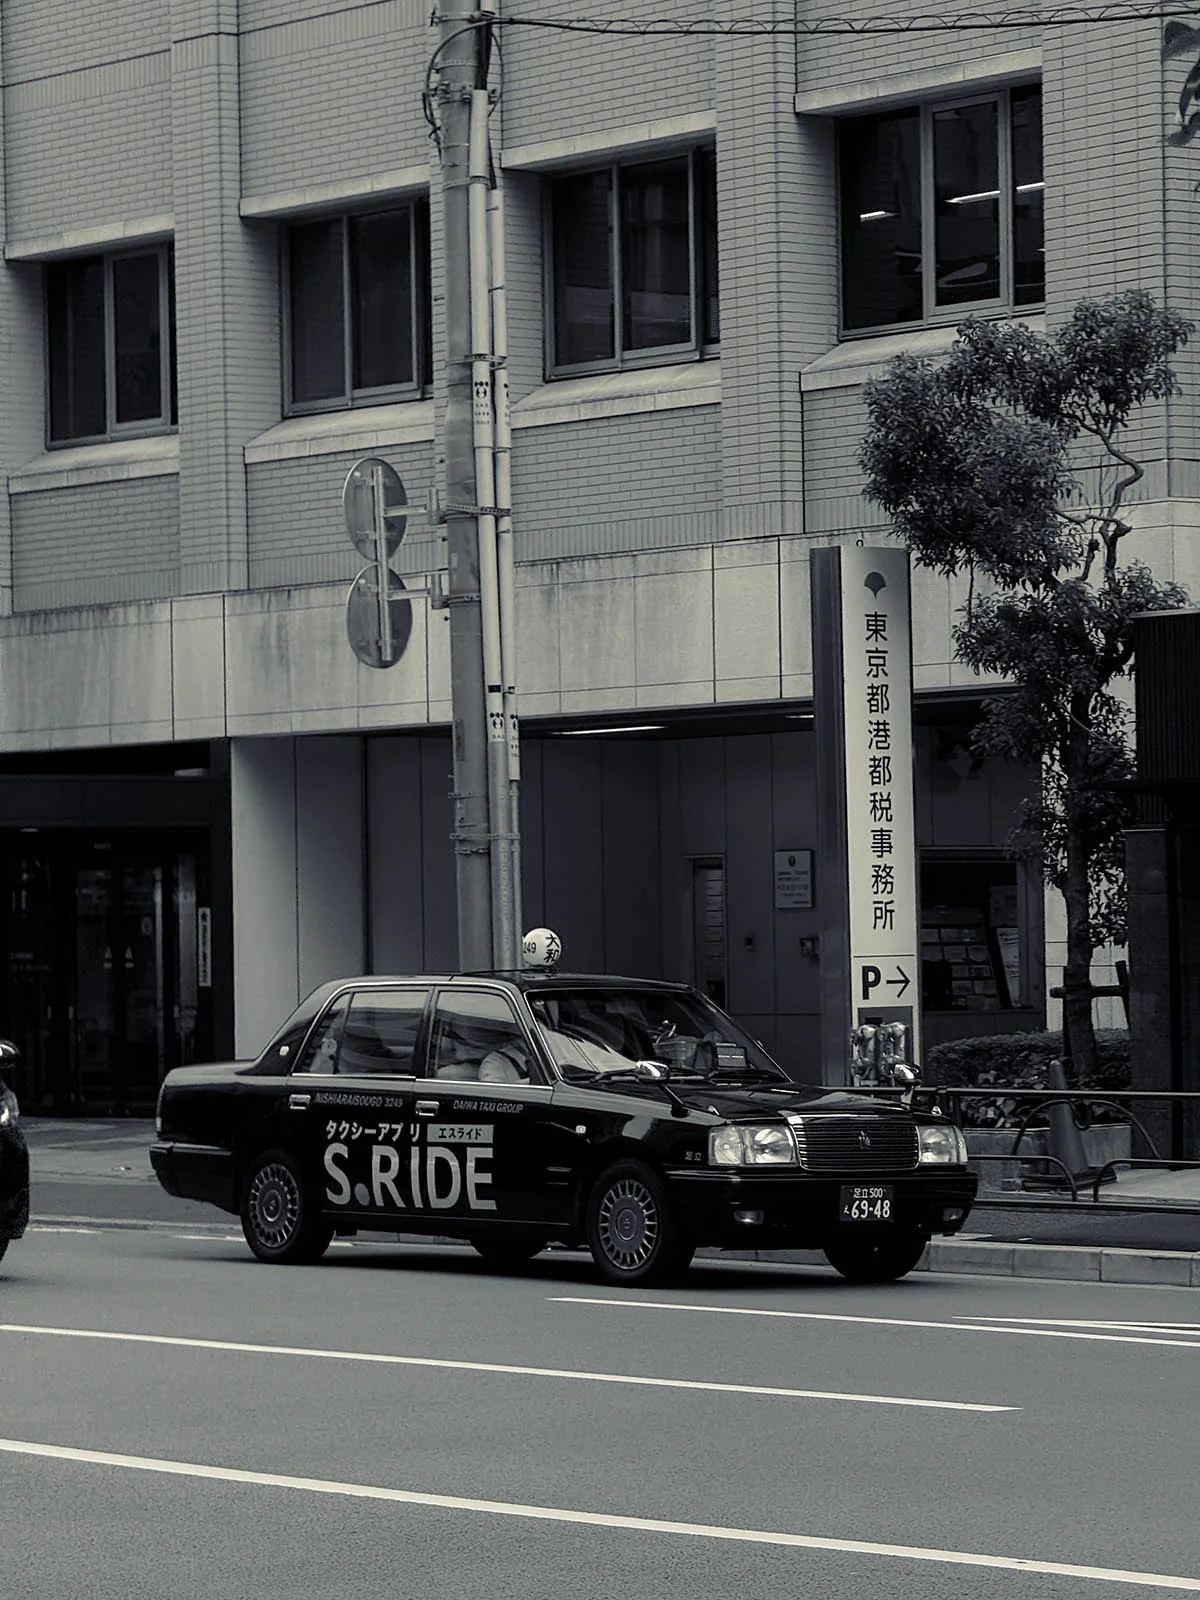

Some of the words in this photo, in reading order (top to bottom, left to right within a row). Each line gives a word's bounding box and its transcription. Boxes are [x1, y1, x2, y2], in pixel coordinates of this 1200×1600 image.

[864, 611, 895, 931] 東京都港都税事務所
[544, 933, 560, 963] 大和
[861, 965, 881, 1000] P
[453, 1100, 478, 1111] DAIWA
[479, 1101, 496, 1112] TAXI
[496, 1103, 524, 1113] GROUP
[438, 1127, 482, 1140] エスライド
[323, 1142, 497, 1210] S.RIDE
[851, 1199, 891, 1219] 69-48
